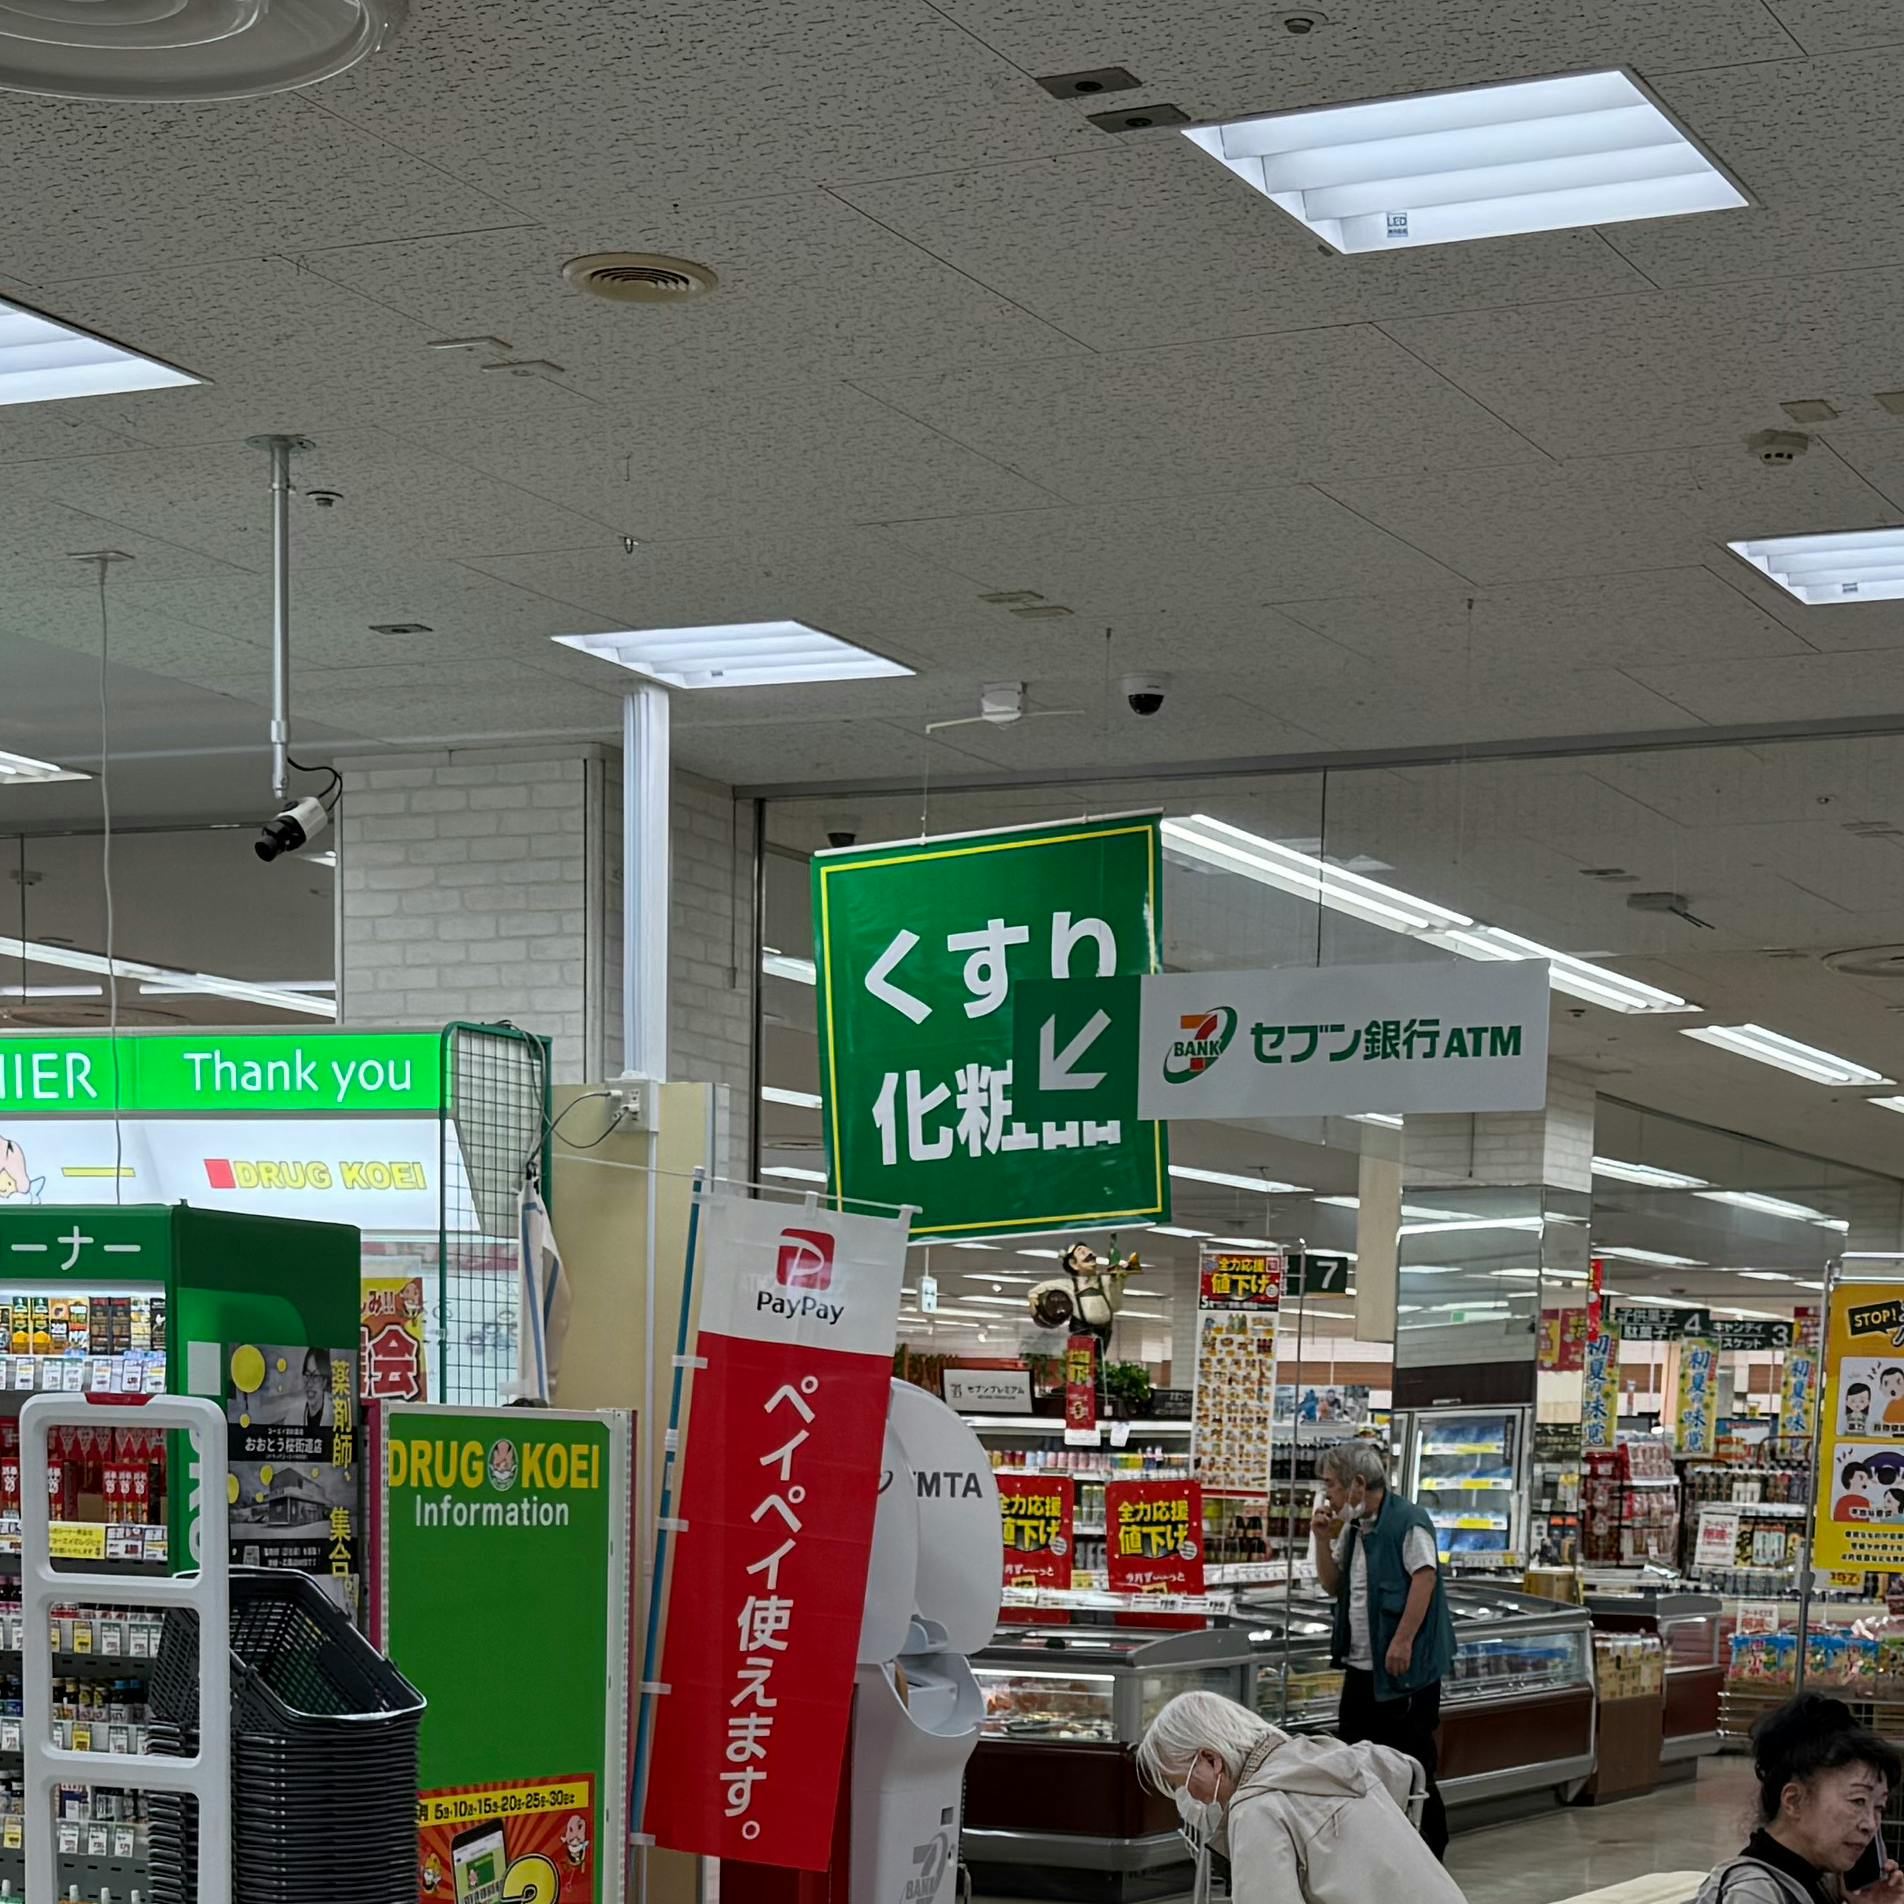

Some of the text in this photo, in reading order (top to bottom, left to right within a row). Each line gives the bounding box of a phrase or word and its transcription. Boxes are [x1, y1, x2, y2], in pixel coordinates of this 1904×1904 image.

[864, 909, 1120, 1027] くすり
[1172, 1038, 1222, 1059] BANK
[184, 1050, 413, 1104] Thank you
[233, 1159, 428, 1192] DRUG KOEI
[1218, 1258, 1265, 1272] 全力応援
[1316, 1260, 1339, 1290] 7
[1211, 1272, 1270, 1297] 値下げ
[756, 1289, 846, 1327] PayPay
[1853, 1307, 1898, 1328] STOP!
[1684, 1313, 1702, 1334] 4
[1713, 1321, 1789, 1346] キャンディ 3
[966, 1384, 1026, 1395] セブンプレミアム
[330, 1359, 354, 1484] 薬剤師、
[244, 1436, 323, 1454] おおとう桜街道店
[387, 1440, 600, 1490] DRUG KOEI
[414, 1495, 570, 1529] Information
[1117, 1500, 1189, 1523] 全力応援
[1118, 1523, 1189, 1557] 値下げ
[719, 1374, 817, 1842] ペイペイ使えます。
